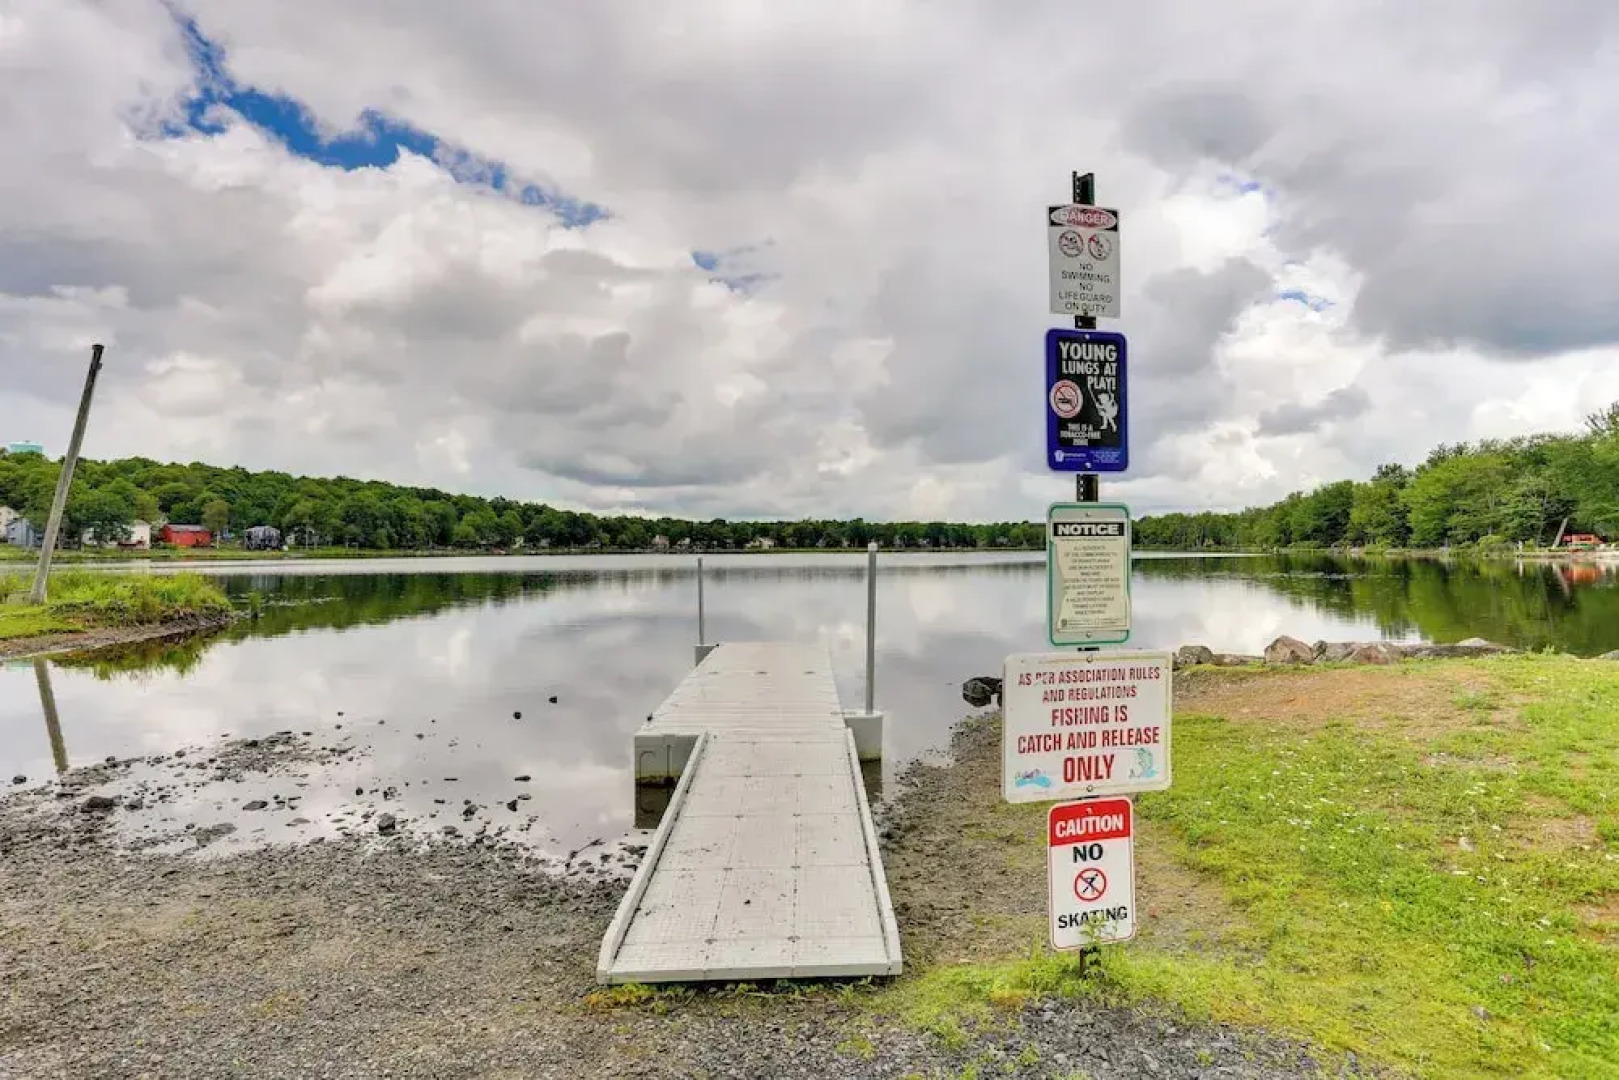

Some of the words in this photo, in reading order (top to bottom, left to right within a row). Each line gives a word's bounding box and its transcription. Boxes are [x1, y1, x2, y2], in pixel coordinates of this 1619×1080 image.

[1060, 210, 1109, 224] DANGER
[1080, 263, 1093, 271] NO
[1062, 270, 1110, 283] SWIMMING
[1080, 283, 1093, 292] NO
[1058, 291, 1112, 303] LIFEGUARD
[1065, 302, 1078, 310] ON
[1059, 342, 1117, 361] YOUNG
[1062, 360, 1100, 374] LUNGS
[1104, 362, 1117, 376] AT
[1088, 376, 1116, 390] PLAY!
[1058, 524, 1119, 535] NOTICE
[1018, 673, 1032, 686] AS
[1058, 668, 1126, 684] ASSOCIATION
[1130, 667, 1160, 680] RULES
[1042, 689, 1064, 703] AND
[1068, 685, 1137, 701] REGULATIONS
[1052, 707, 1109, 727] FISHING
[1115, 706, 1128, 722] IS
[1018, 732, 1062, 754] CATCH
[1066, 732, 1096, 750] AND
[1102, 727, 1160, 748] RELEASE
[1063, 754, 1115, 783] ONLY
[1056, 814, 1124, 838] CAUTION
[1072, 843, 1103, 863] NO
[1058, 906, 1128, 928] SKATING
